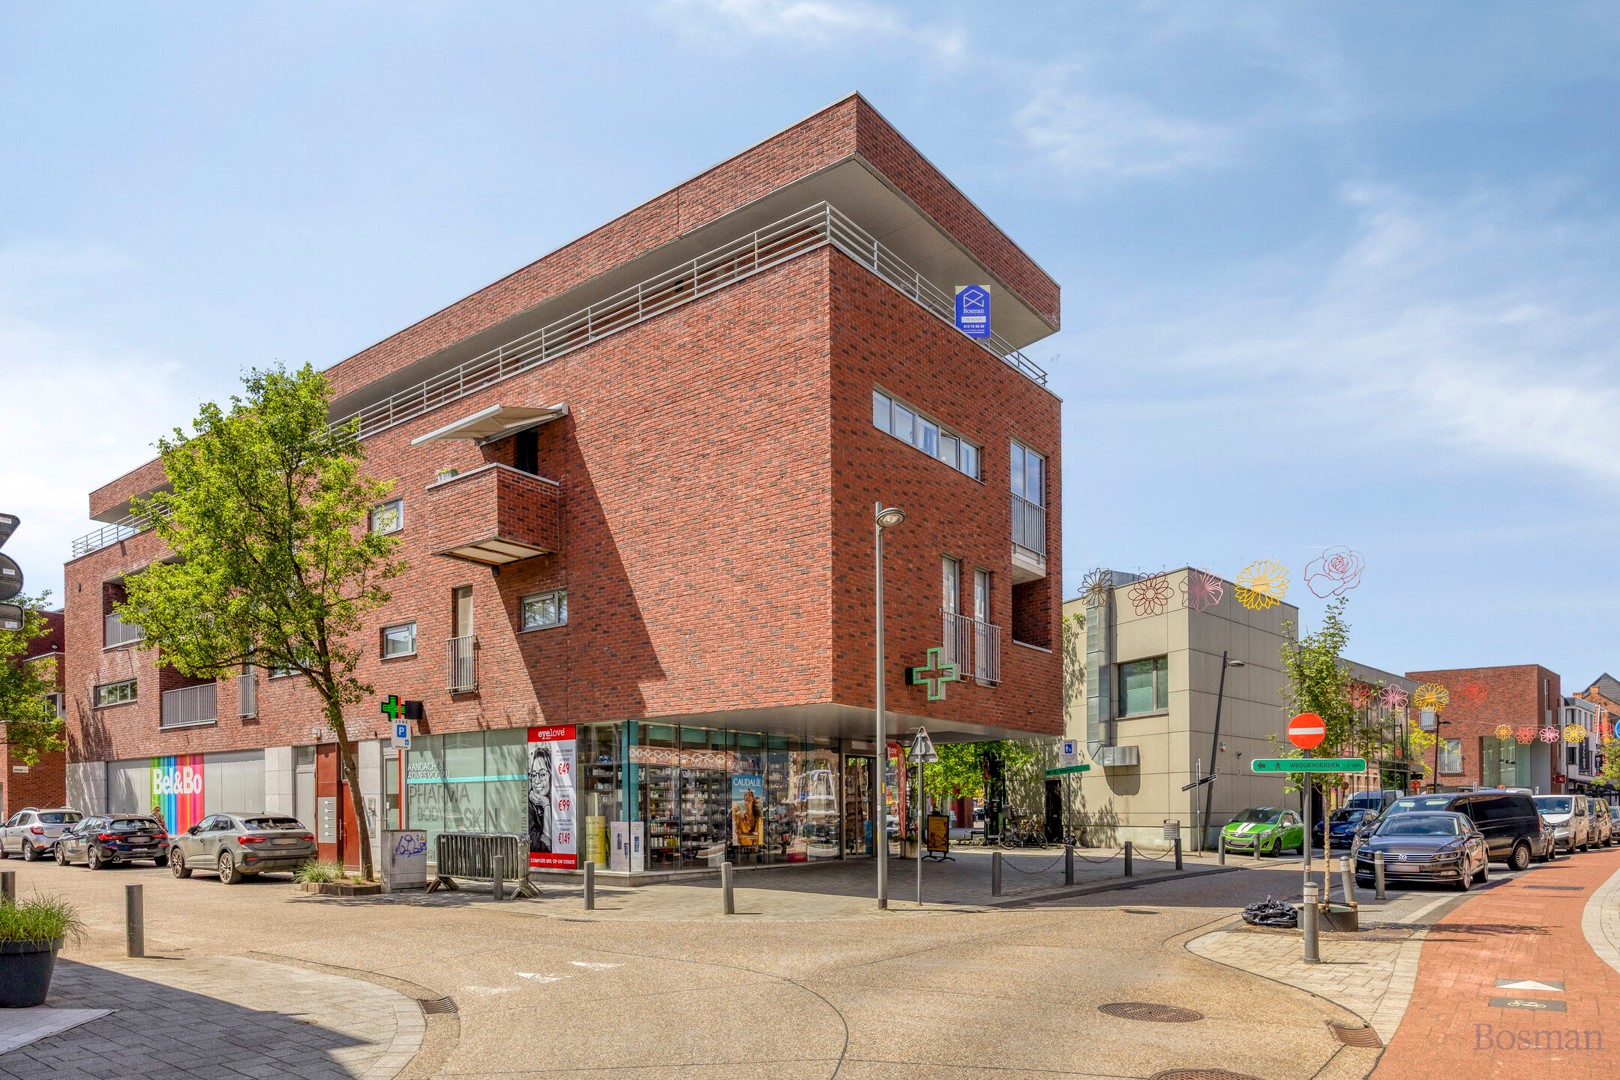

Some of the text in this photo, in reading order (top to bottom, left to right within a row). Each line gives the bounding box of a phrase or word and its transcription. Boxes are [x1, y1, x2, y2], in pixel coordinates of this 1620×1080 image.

[398, 726, 405, 736] P
[557, 762, 571, 775] €49
[153, 766, 202, 795] Bel&Bo
[558, 799, 571, 812] €99
[558, 832, 571, 845] €149
